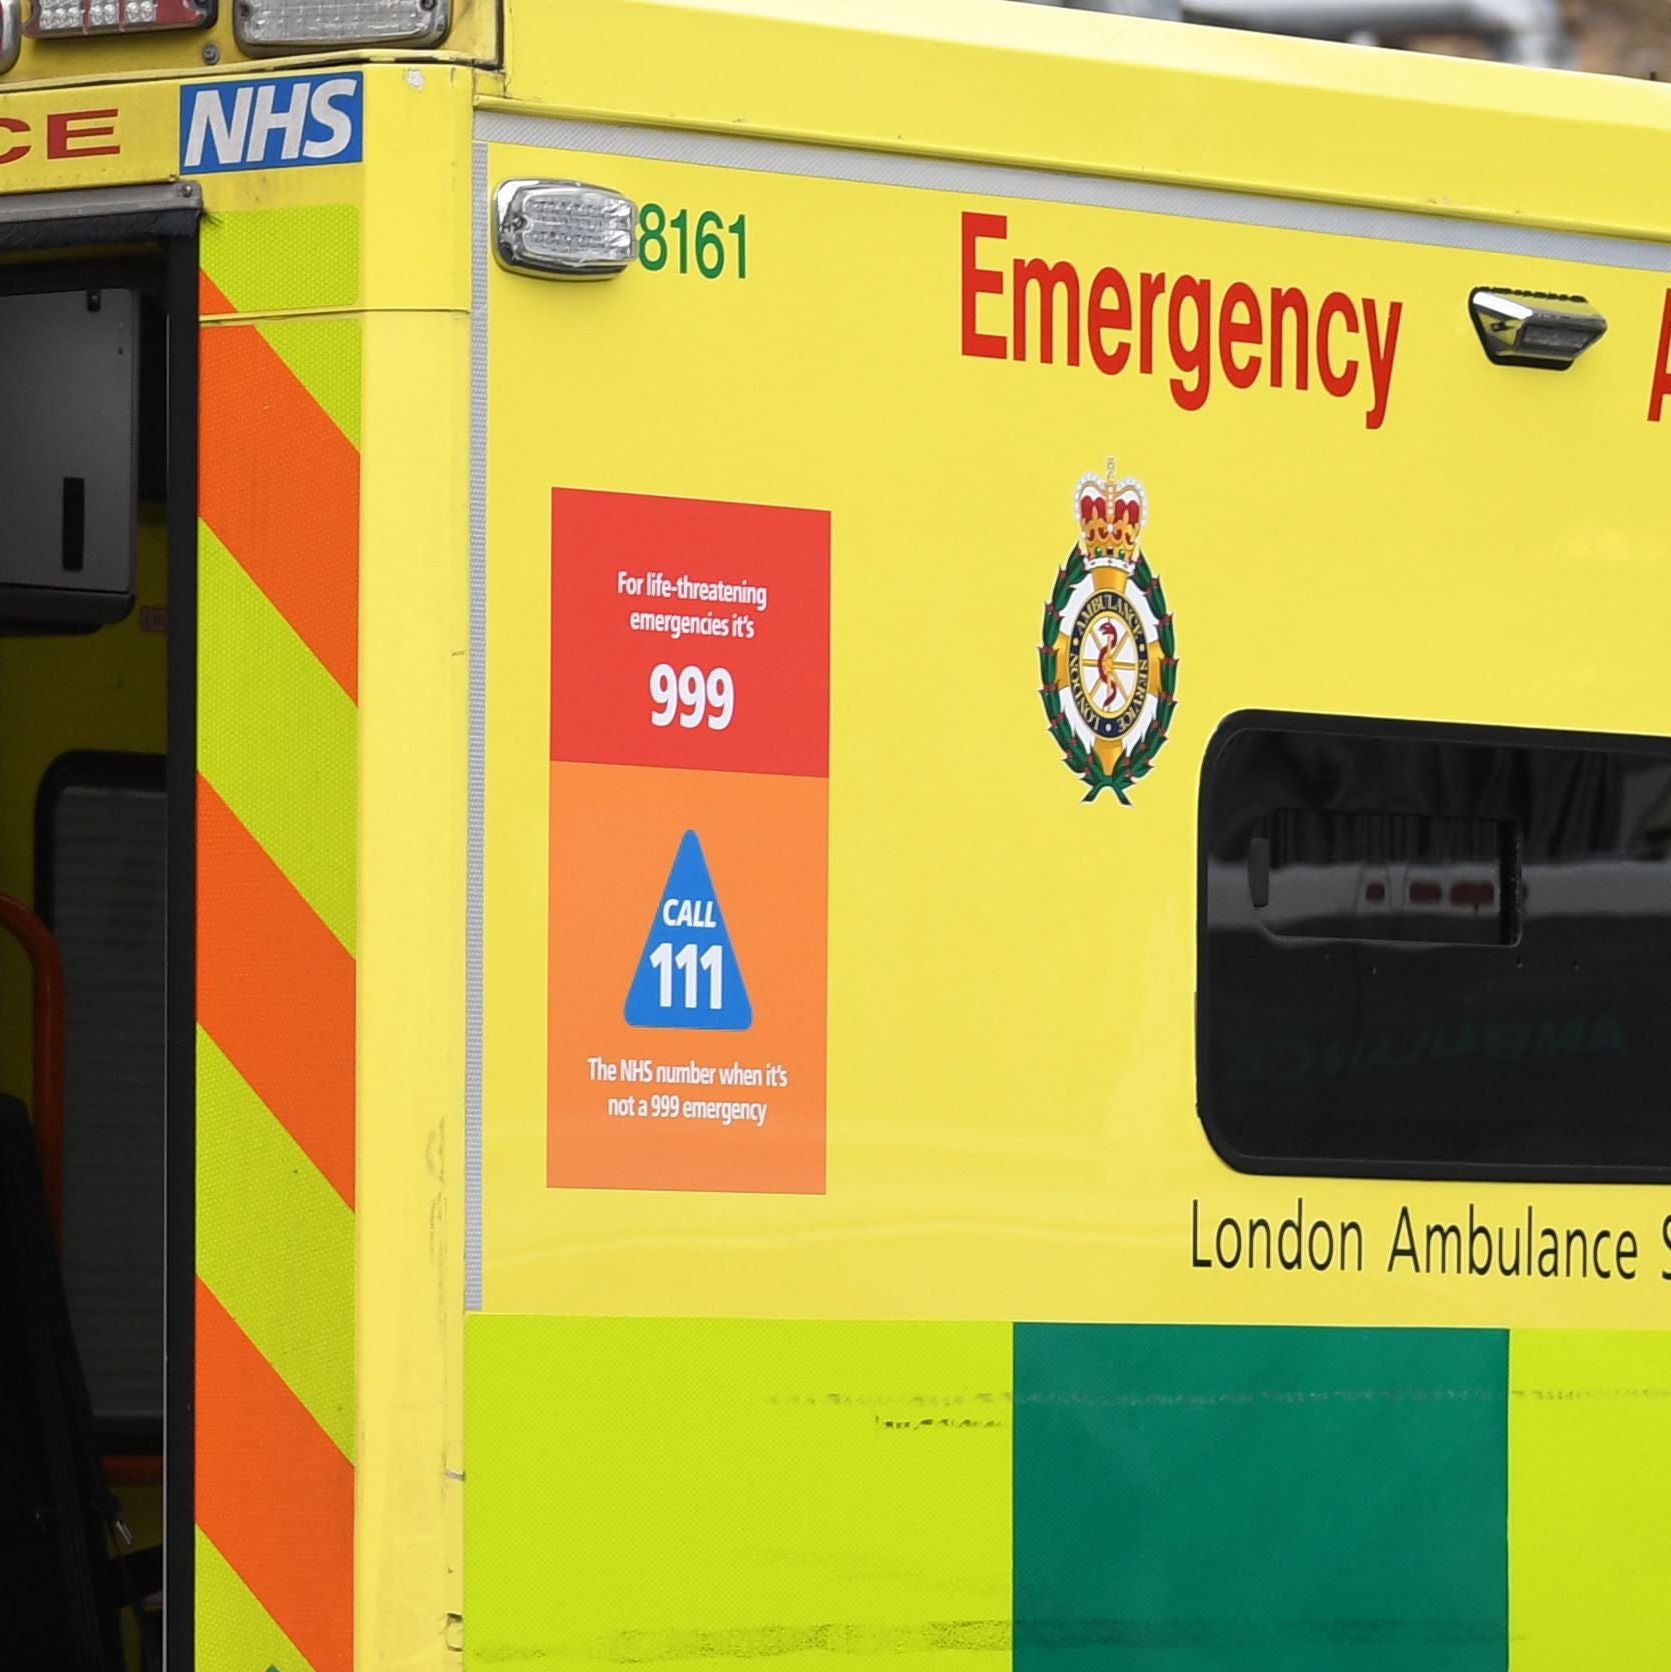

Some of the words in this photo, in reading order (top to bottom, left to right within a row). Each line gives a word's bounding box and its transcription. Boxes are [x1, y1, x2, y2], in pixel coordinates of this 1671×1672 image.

[187, 79, 358, 168] NHS
[637, 202, 749, 278] 8161
[961, 211, 1404, 430] Emergency
[617, 571, 644, 596] For
[646, 572, 768, 612] life-threatening
[1075, 593, 1144, 640] AMBULANCE
[630, 611, 729, 639] emergencies
[732, 613, 756, 639] it's
[649, 663, 735, 730] 999
[662, 899, 717, 928] CALL
[650, 943, 723, 1010] 111
[587, 1057, 617, 1082] The
[620, 1059, 653, 1084] NHS
[656, 1061, 716, 1086] number
[718, 1062, 762, 1087] when
[765, 1064, 788, 1088] it's
[609, 1096, 635, 1117] not
[638, 1100, 648, 1117] a
[651, 1094, 680, 1118] 999
[682, 1098, 768, 1127] emergency
[1191, 1198, 1364, 1272] London
[1387, 1204, 1639, 1279] Ambulance
